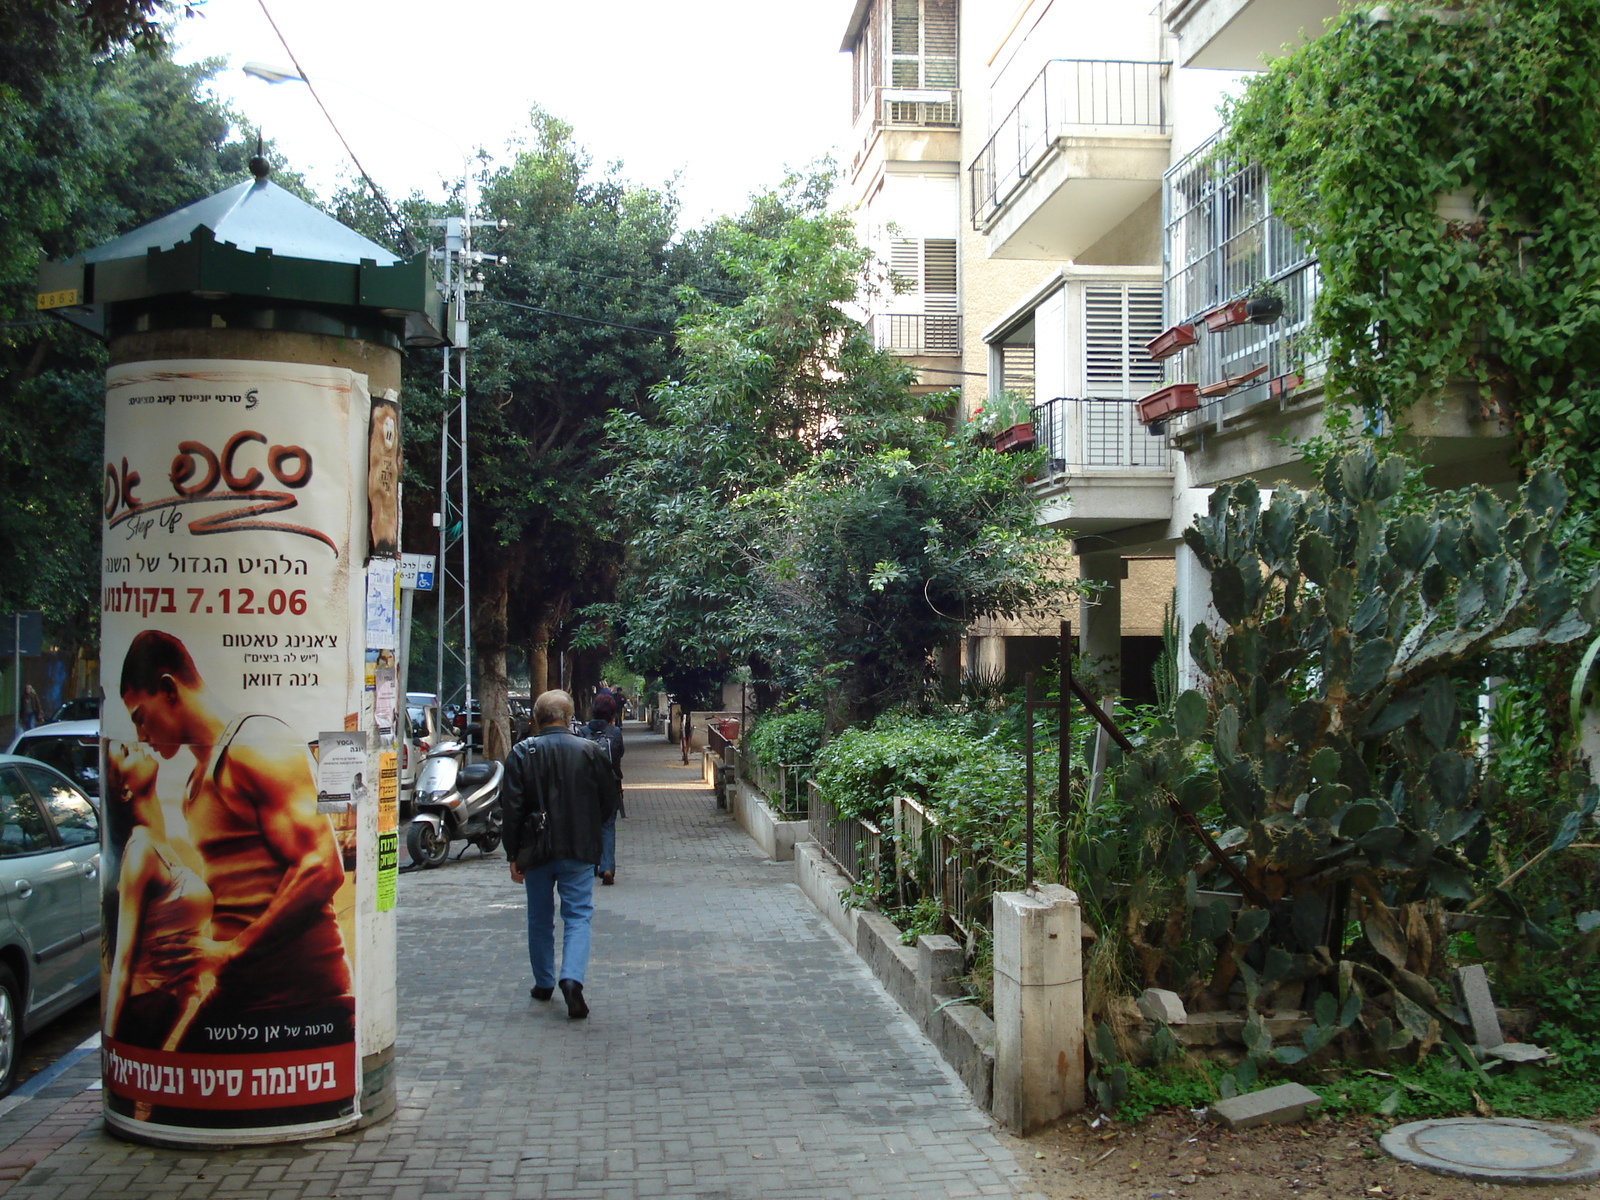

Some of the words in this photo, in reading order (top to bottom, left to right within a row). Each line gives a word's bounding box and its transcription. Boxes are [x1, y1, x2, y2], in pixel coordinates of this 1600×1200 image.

[157, 395, 176, 406] קינג
[215, 394, 242, 403] סרטי
[126, 514, 155, 540] Step
[136, 552, 160, 573] של
[168, 552, 228, 574] הגדול
[238, 554, 308, 575] הלהיט
[187, 588, 307, 615] 7.12.06
[222, 634, 279, 648] טאטום
[285, 634, 338, 648] צ'אנינג
[283, 652, 297, 663] לה
[243, 673, 283, 690] דוואן
[289, 673, 319, 686] ג'נה
[204, 1024, 259, 1040] פלטשר
[265, 1025, 280, 1043] אן
[284, 1025, 301, 1037] של
[304, 1023, 334, 1036] סרטה
[109, 1047, 184, 1095] ובעזריאלי
[252, 1061, 336, 1096] בסינמה
[191, 1068, 243, 1097] סיטי
